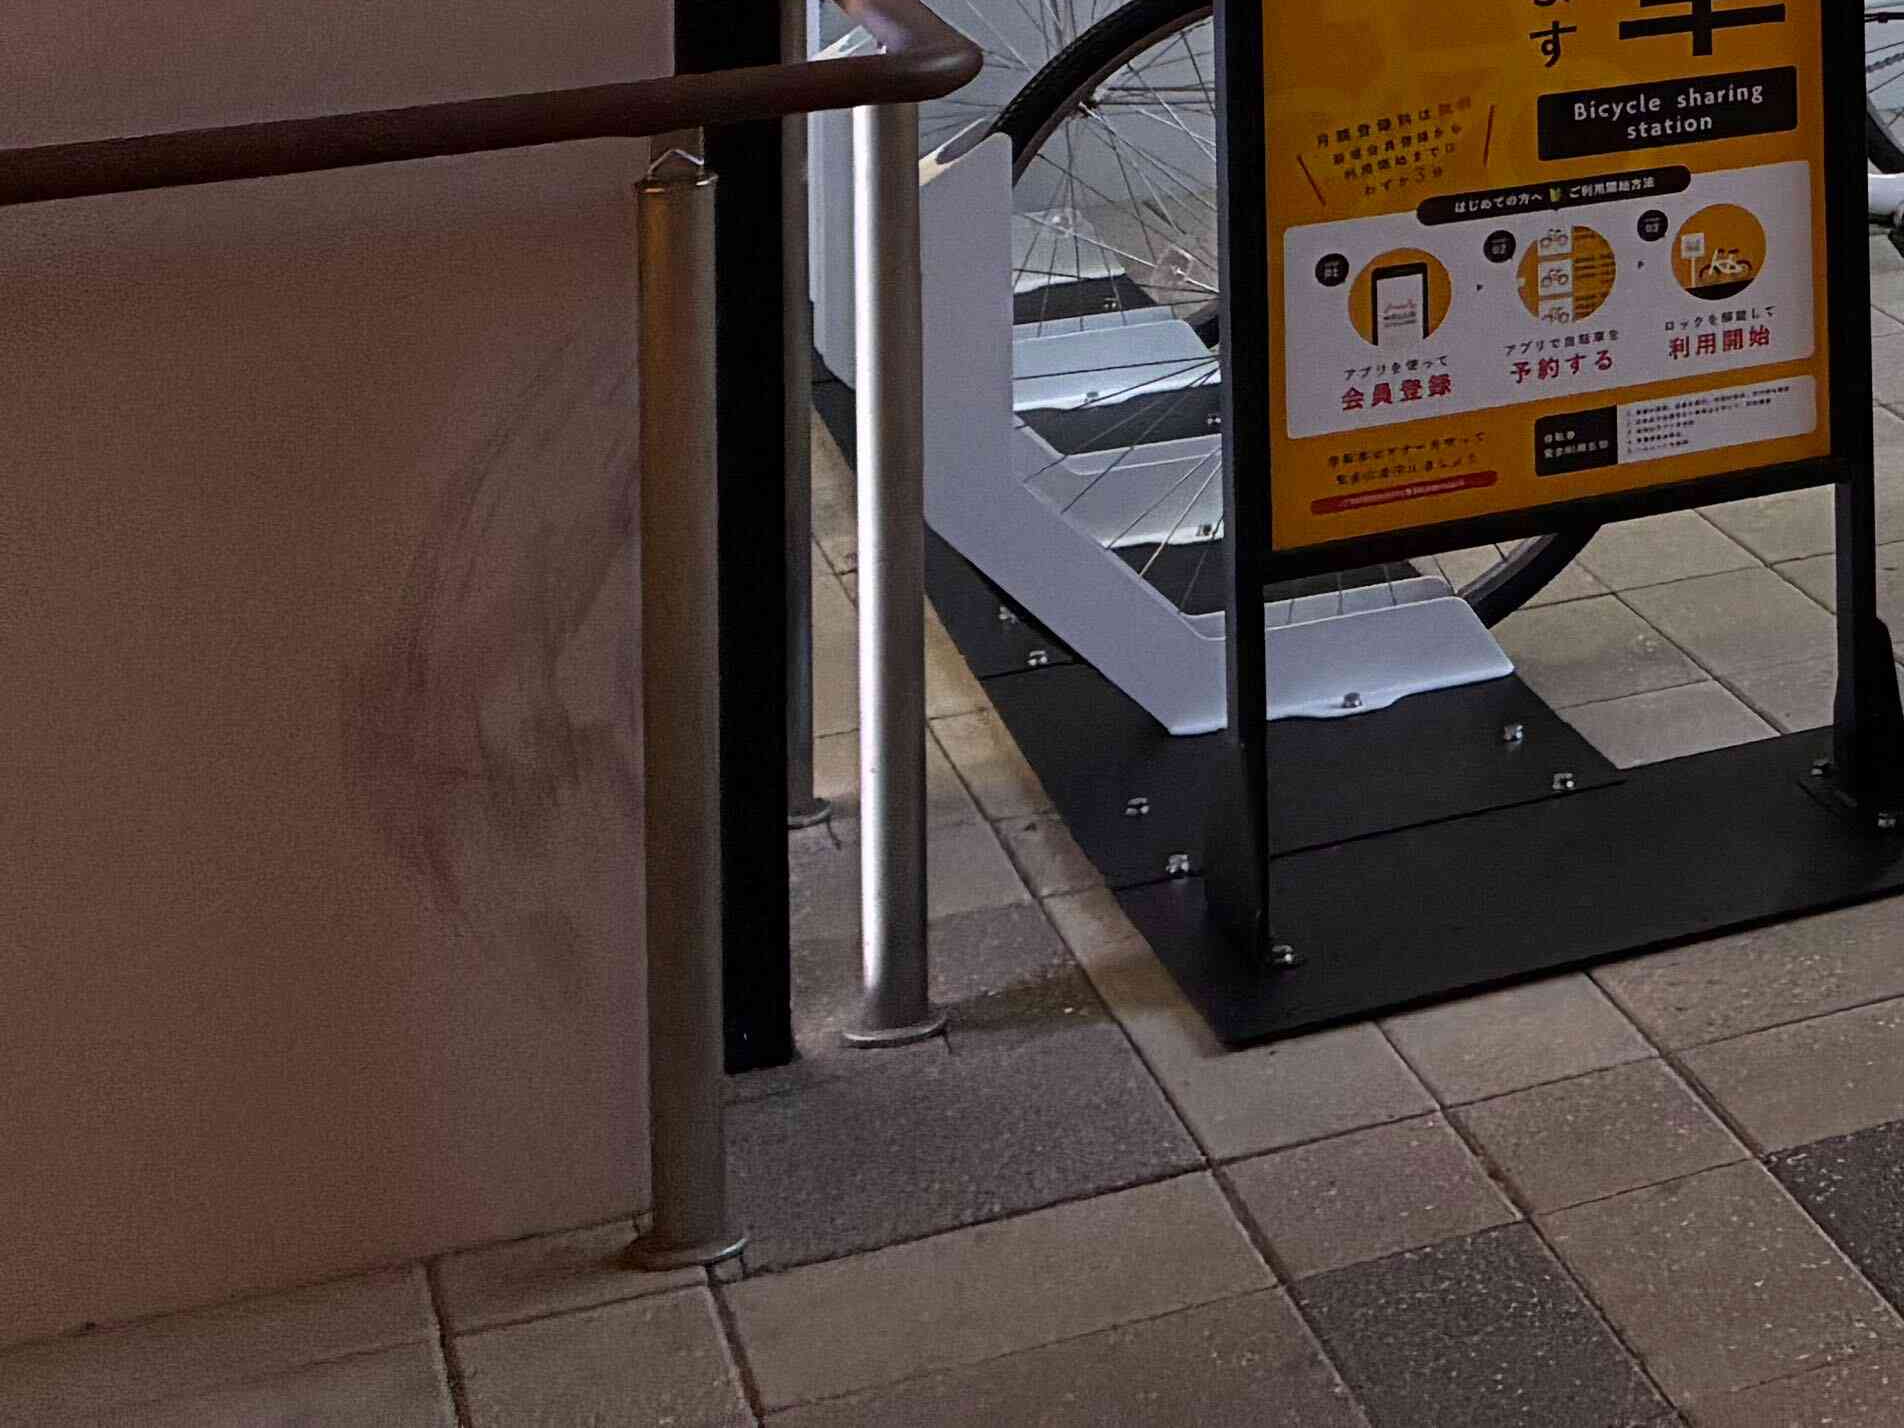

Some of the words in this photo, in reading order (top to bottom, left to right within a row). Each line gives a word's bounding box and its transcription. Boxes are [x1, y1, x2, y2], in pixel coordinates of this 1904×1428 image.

[1573, 92, 1661, 123] Bicycle
[1677, 83, 1765, 109] sharing
[1626, 113, 1714, 140] station
[1454, 192, 1544, 214] はじめての方へ
[1668, 325, 1771, 361] 利用開始
[1509, 349, 1614, 385] 予約する
[1341, 372, 1452, 412] 会員登録
